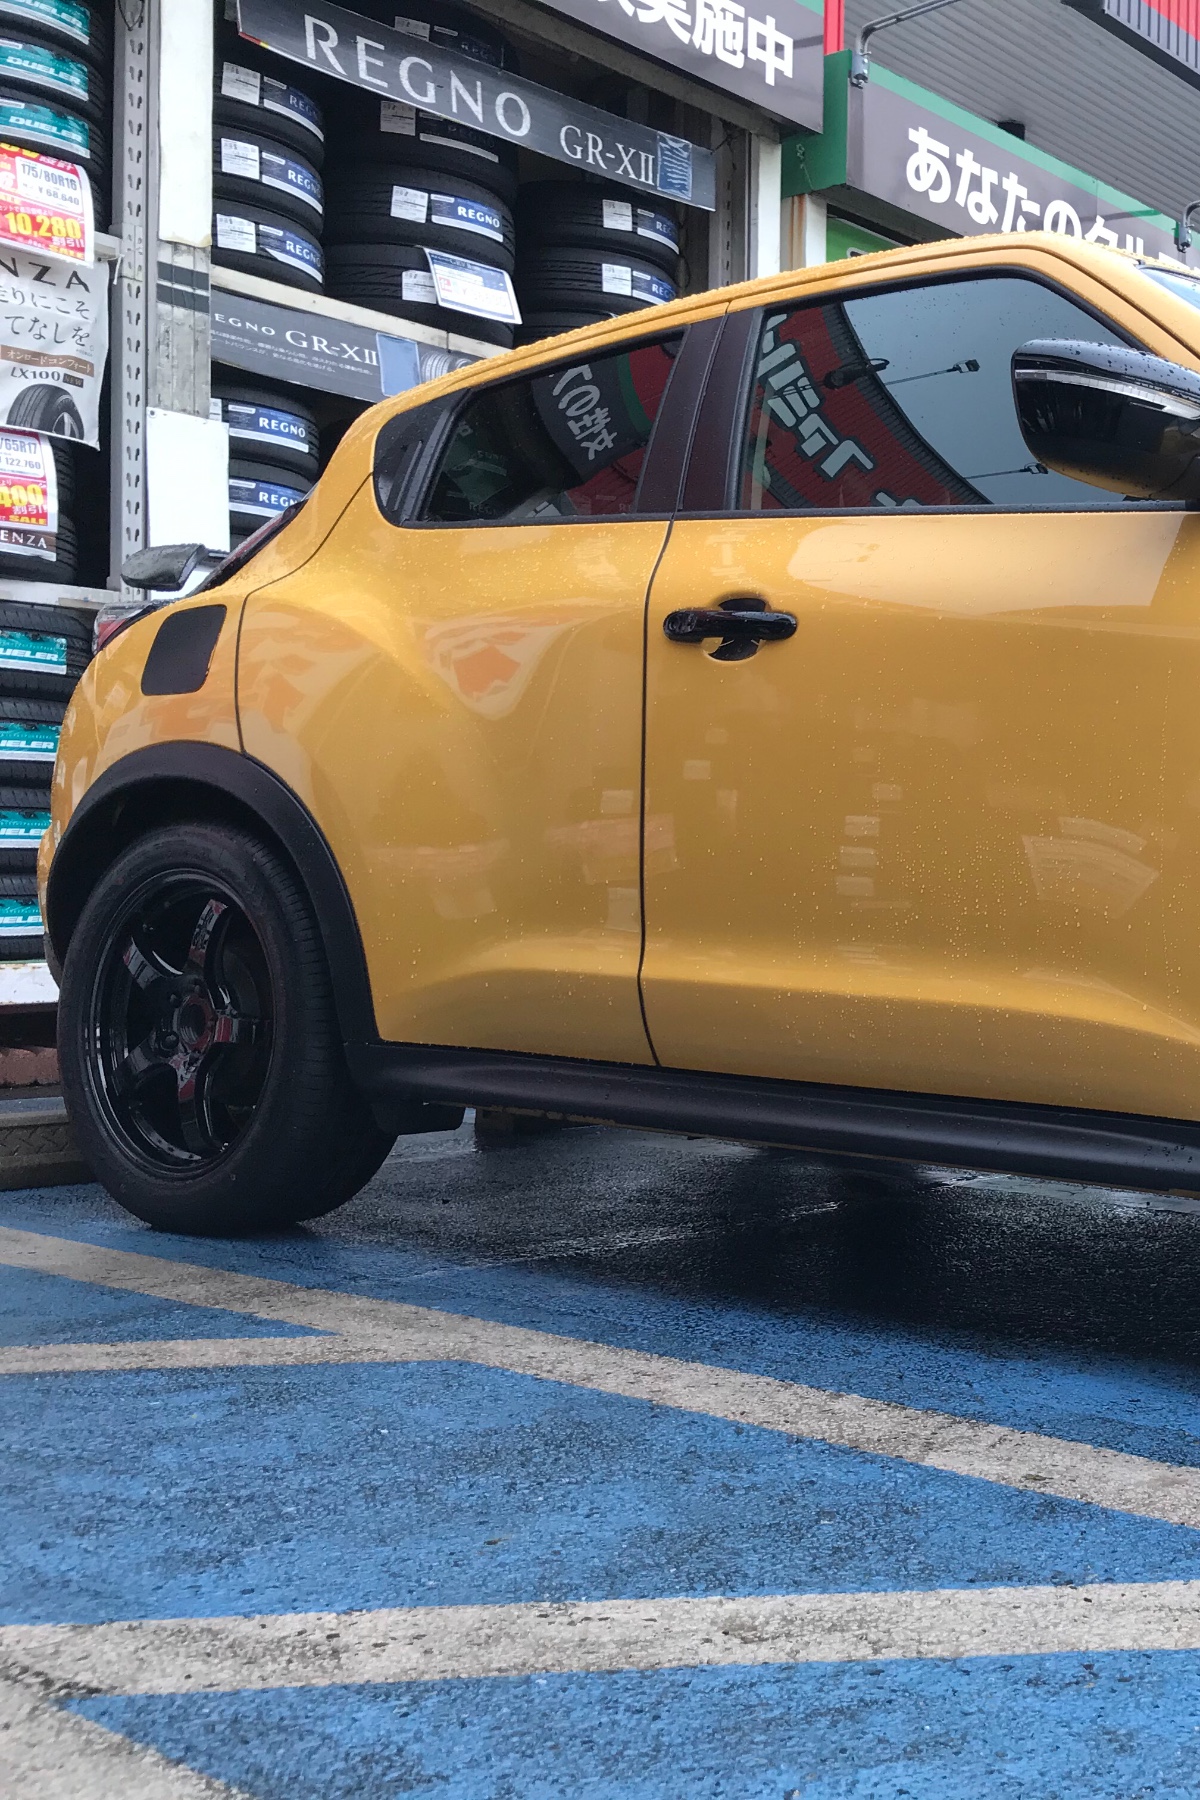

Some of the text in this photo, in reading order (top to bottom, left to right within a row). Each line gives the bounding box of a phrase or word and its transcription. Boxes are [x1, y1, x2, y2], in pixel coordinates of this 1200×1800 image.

[17, 0, 82, 27] UELER
[600, 0, 794, 87] 実施中
[6, 56, 81, 84] DUELER
[304, 14, 532, 138] REGNO
[560, 124, 656, 186] GR-XII
[9, 115, 84, 142] DUELER
[21, 163, 78, 191] 175/80R16
[5, 212, 82, 240] 10,280
[457, 205, 501, 228] REGNO
[285, 330, 380, 367] GR-XII
[10, 366, 61, 382] LX100
[259, 416, 306, 438] REGNO
[8, 514, 47, 525] SALE
[0, 529, 47, 549] ENZA
[0, 915, 42, 924] ELE
